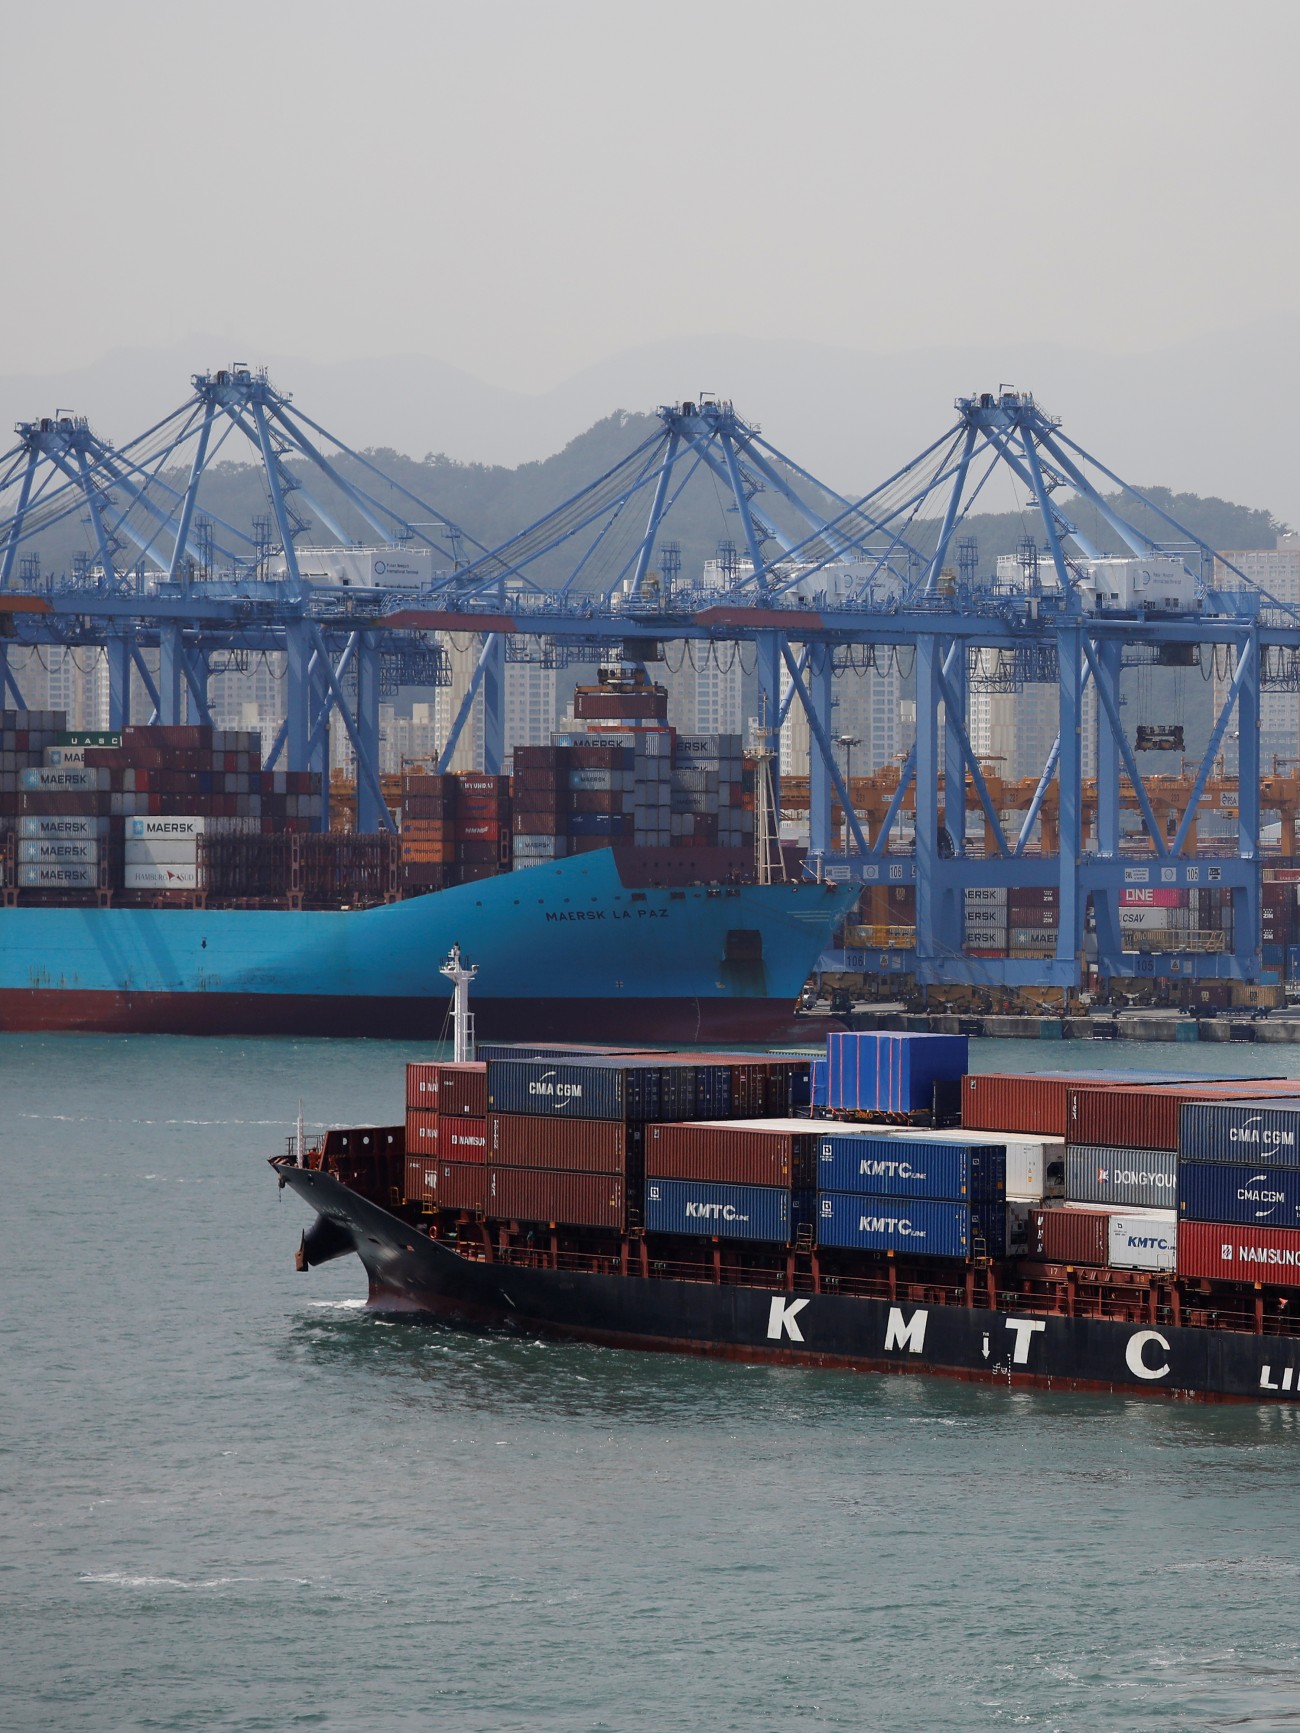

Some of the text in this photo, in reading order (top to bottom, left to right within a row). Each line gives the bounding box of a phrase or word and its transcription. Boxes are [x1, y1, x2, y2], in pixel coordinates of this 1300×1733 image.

[40, 774, 87, 784] MAERSK
[40, 822, 87, 832] MAERSK
[147, 823, 193, 832] MAERSK
[40, 846, 87, 856] MAERSK
[40, 870, 87, 880] MAERSK
[135, 872, 167, 881] HAMBURG
[890, 865, 902, 878] 106
[1187, 867, 1198, 880] 105
[966, 890, 996, 899] ERSK
[1126, 889, 1153, 901] ONE
[545, 909, 670, 922] MAERSK LA PAZ
[966, 912, 996, 921] ERSK
[1122, 914, 1144, 923] CSAV
[847, 955, 863, 967] 106
[1137, 960, 1153, 972] 105
[529, 1082, 582, 1097] CMA CGM
[1229, 1128, 1294, 1146] CMA CGM
[859, 1159, 927, 1180] KMTC LINE
[1237, 1189, 1285, 1203] CMA CGM
[686, 1201, 749, 1222] KMTC LINE
[859, 1216, 926, 1238] KMTC LINE
[1128, 1236, 1168, 1250] KMTC
[1050, 1267, 1058, 1275] 17
